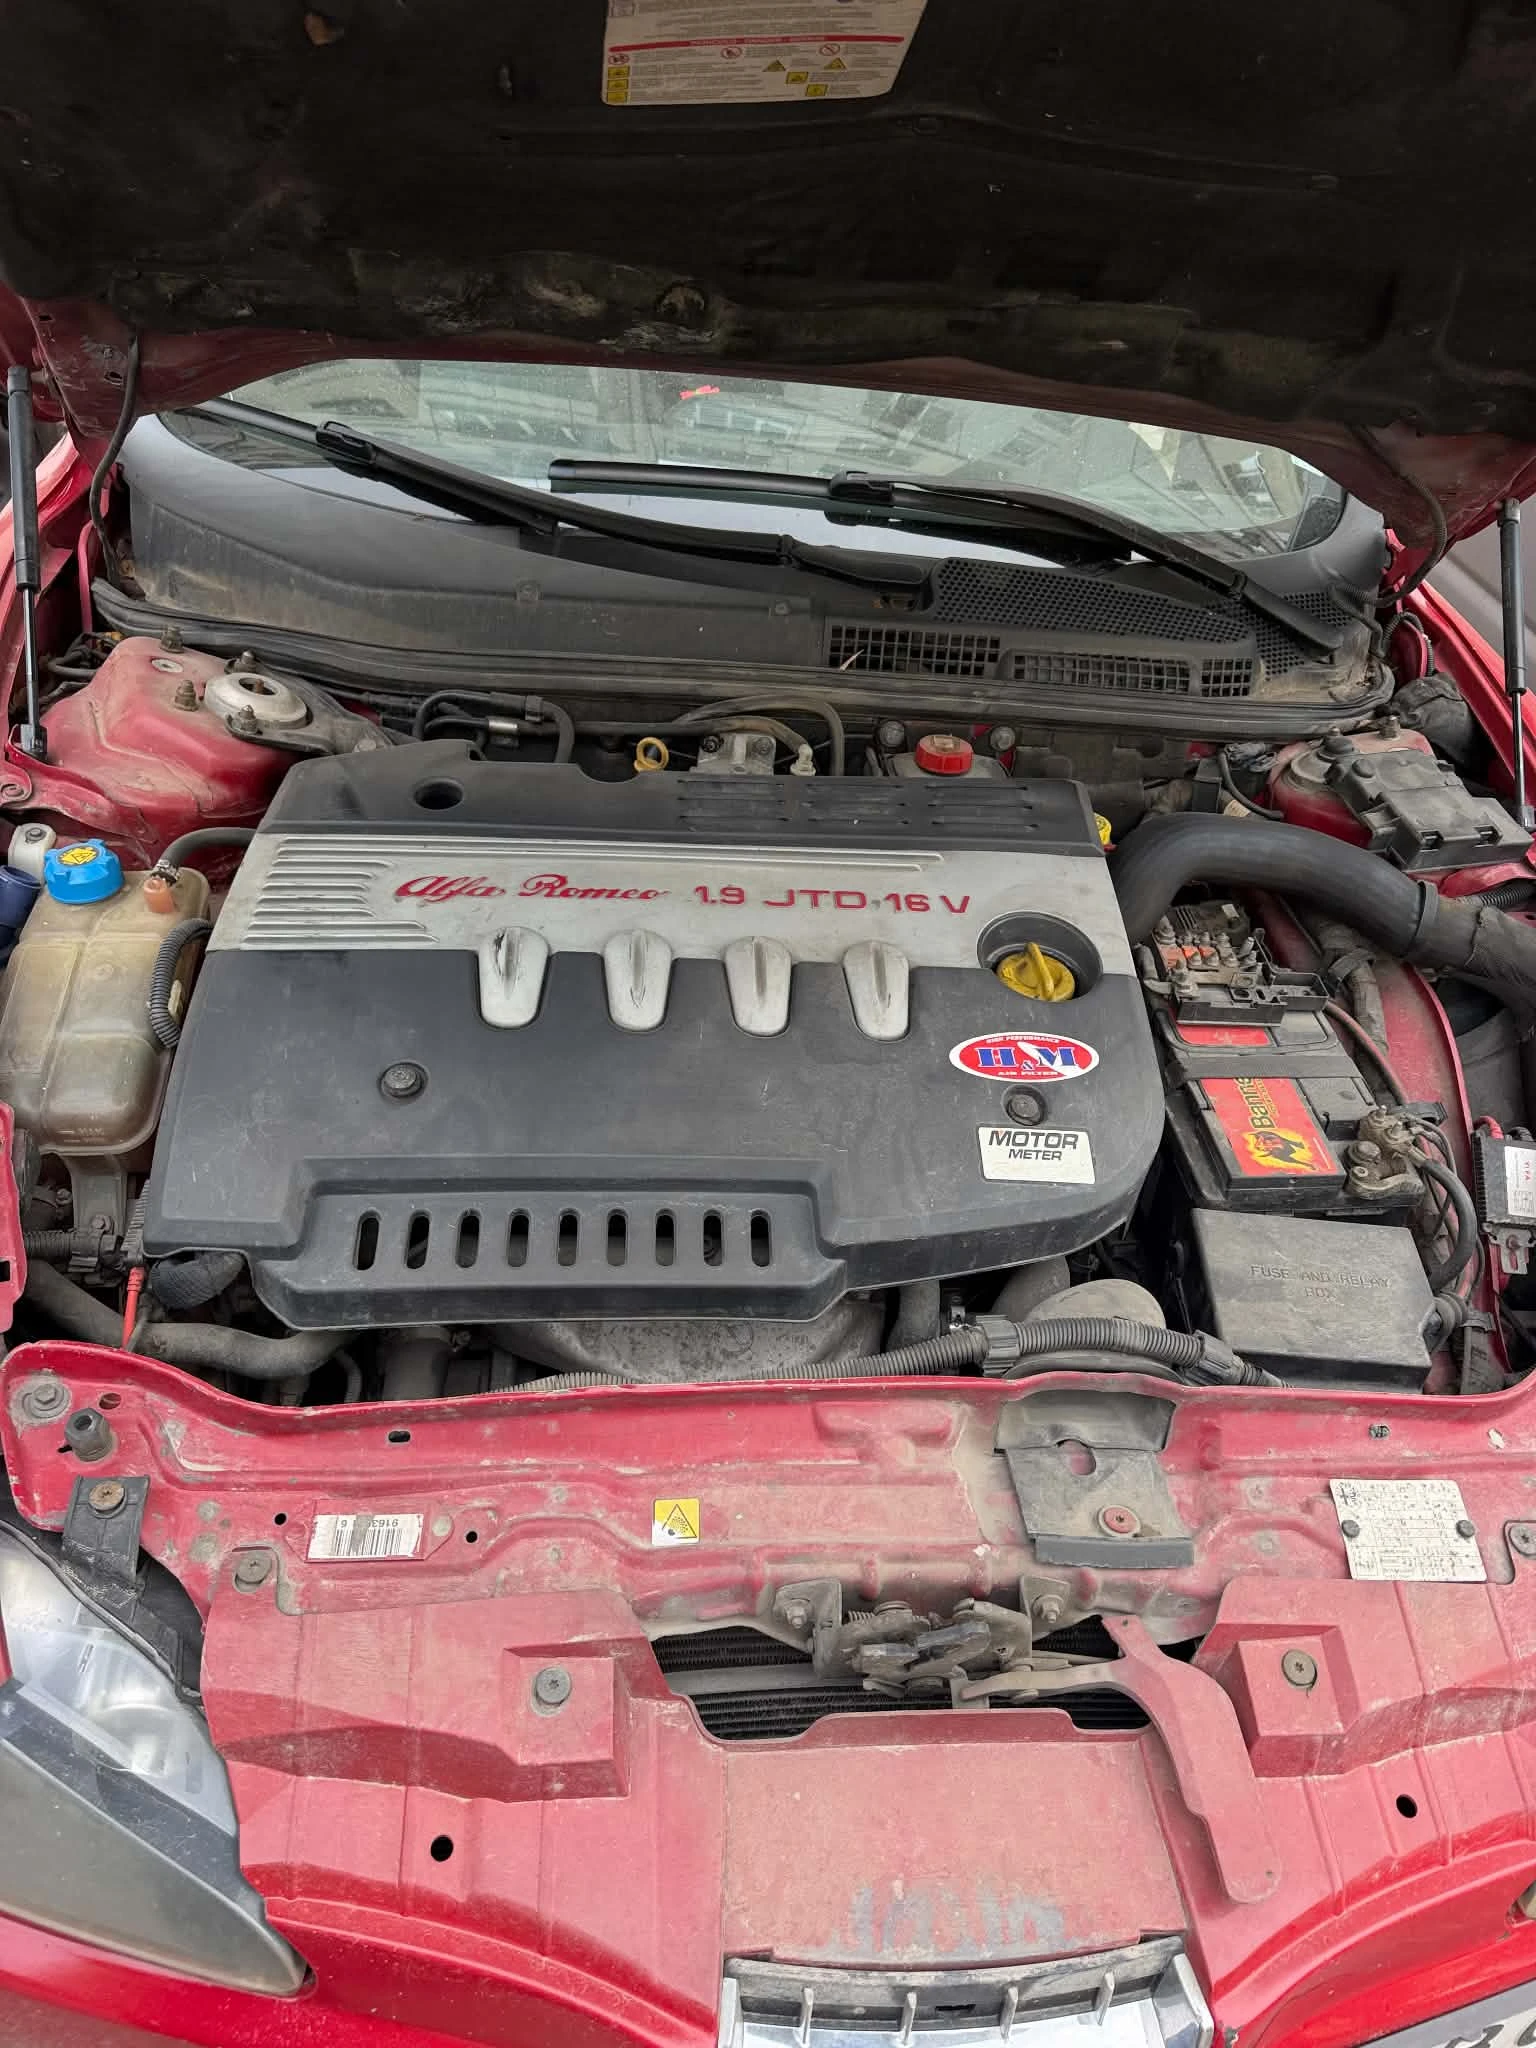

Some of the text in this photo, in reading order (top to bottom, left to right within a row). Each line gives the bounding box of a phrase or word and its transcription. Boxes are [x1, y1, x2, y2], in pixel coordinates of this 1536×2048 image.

[394, 873, 671, 903] Alfa Romeo
[694, 885, 745, 905] 1.9
[763, 889, 868, 909] JTD
[1234, 1078, 1277, 1129] Banne
[988, 1130, 1079, 1149] MOTOR
[1009, 1149, 1063, 1160] METER
[1250, 1265, 1393, 1288] FUSE AND RELAY
[1304, 1287, 1337, 1299] BOX
